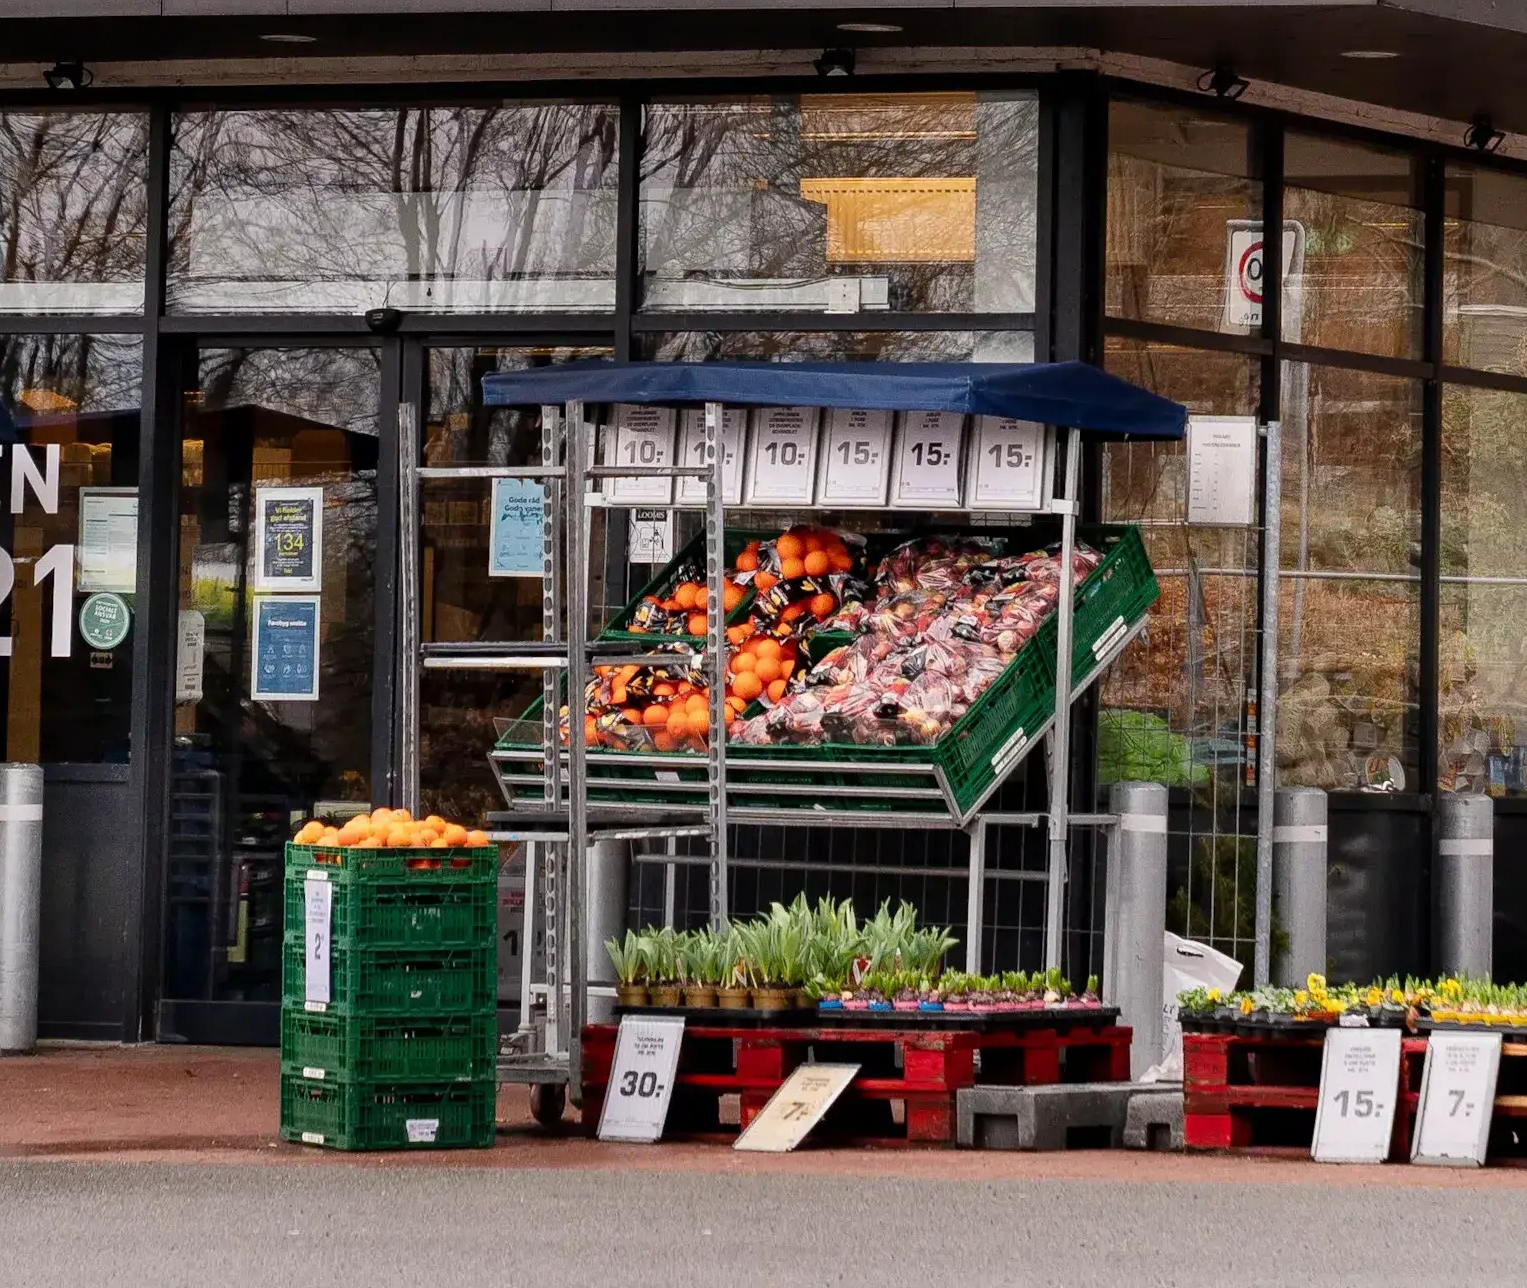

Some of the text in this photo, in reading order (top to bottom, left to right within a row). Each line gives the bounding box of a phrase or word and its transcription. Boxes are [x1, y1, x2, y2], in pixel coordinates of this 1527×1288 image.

[508, 496, 541, 504] Gode råd
[275, 532, 305, 551] 134
